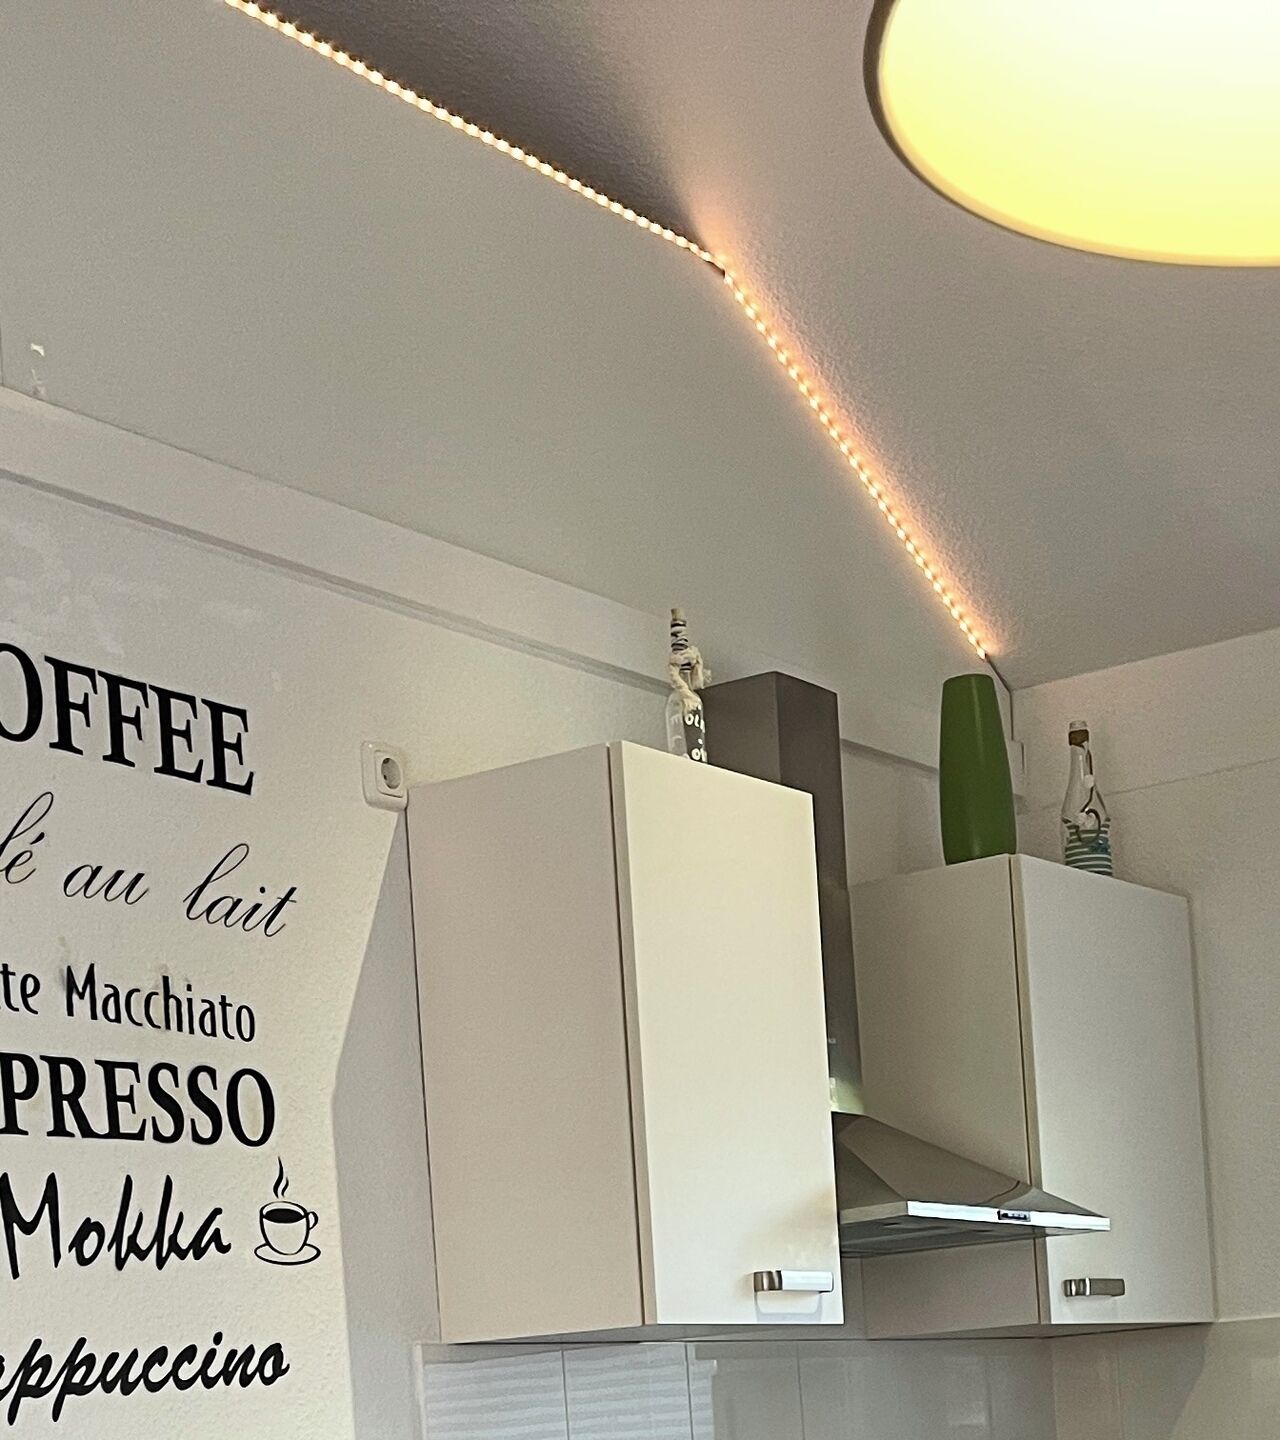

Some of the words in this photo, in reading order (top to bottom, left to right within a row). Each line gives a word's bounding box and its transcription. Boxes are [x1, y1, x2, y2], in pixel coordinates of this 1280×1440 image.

[63, 864, 149, 906] au
[182, 843, 297, 938] lait
[65, 962, 256, 1043] Macchiato
